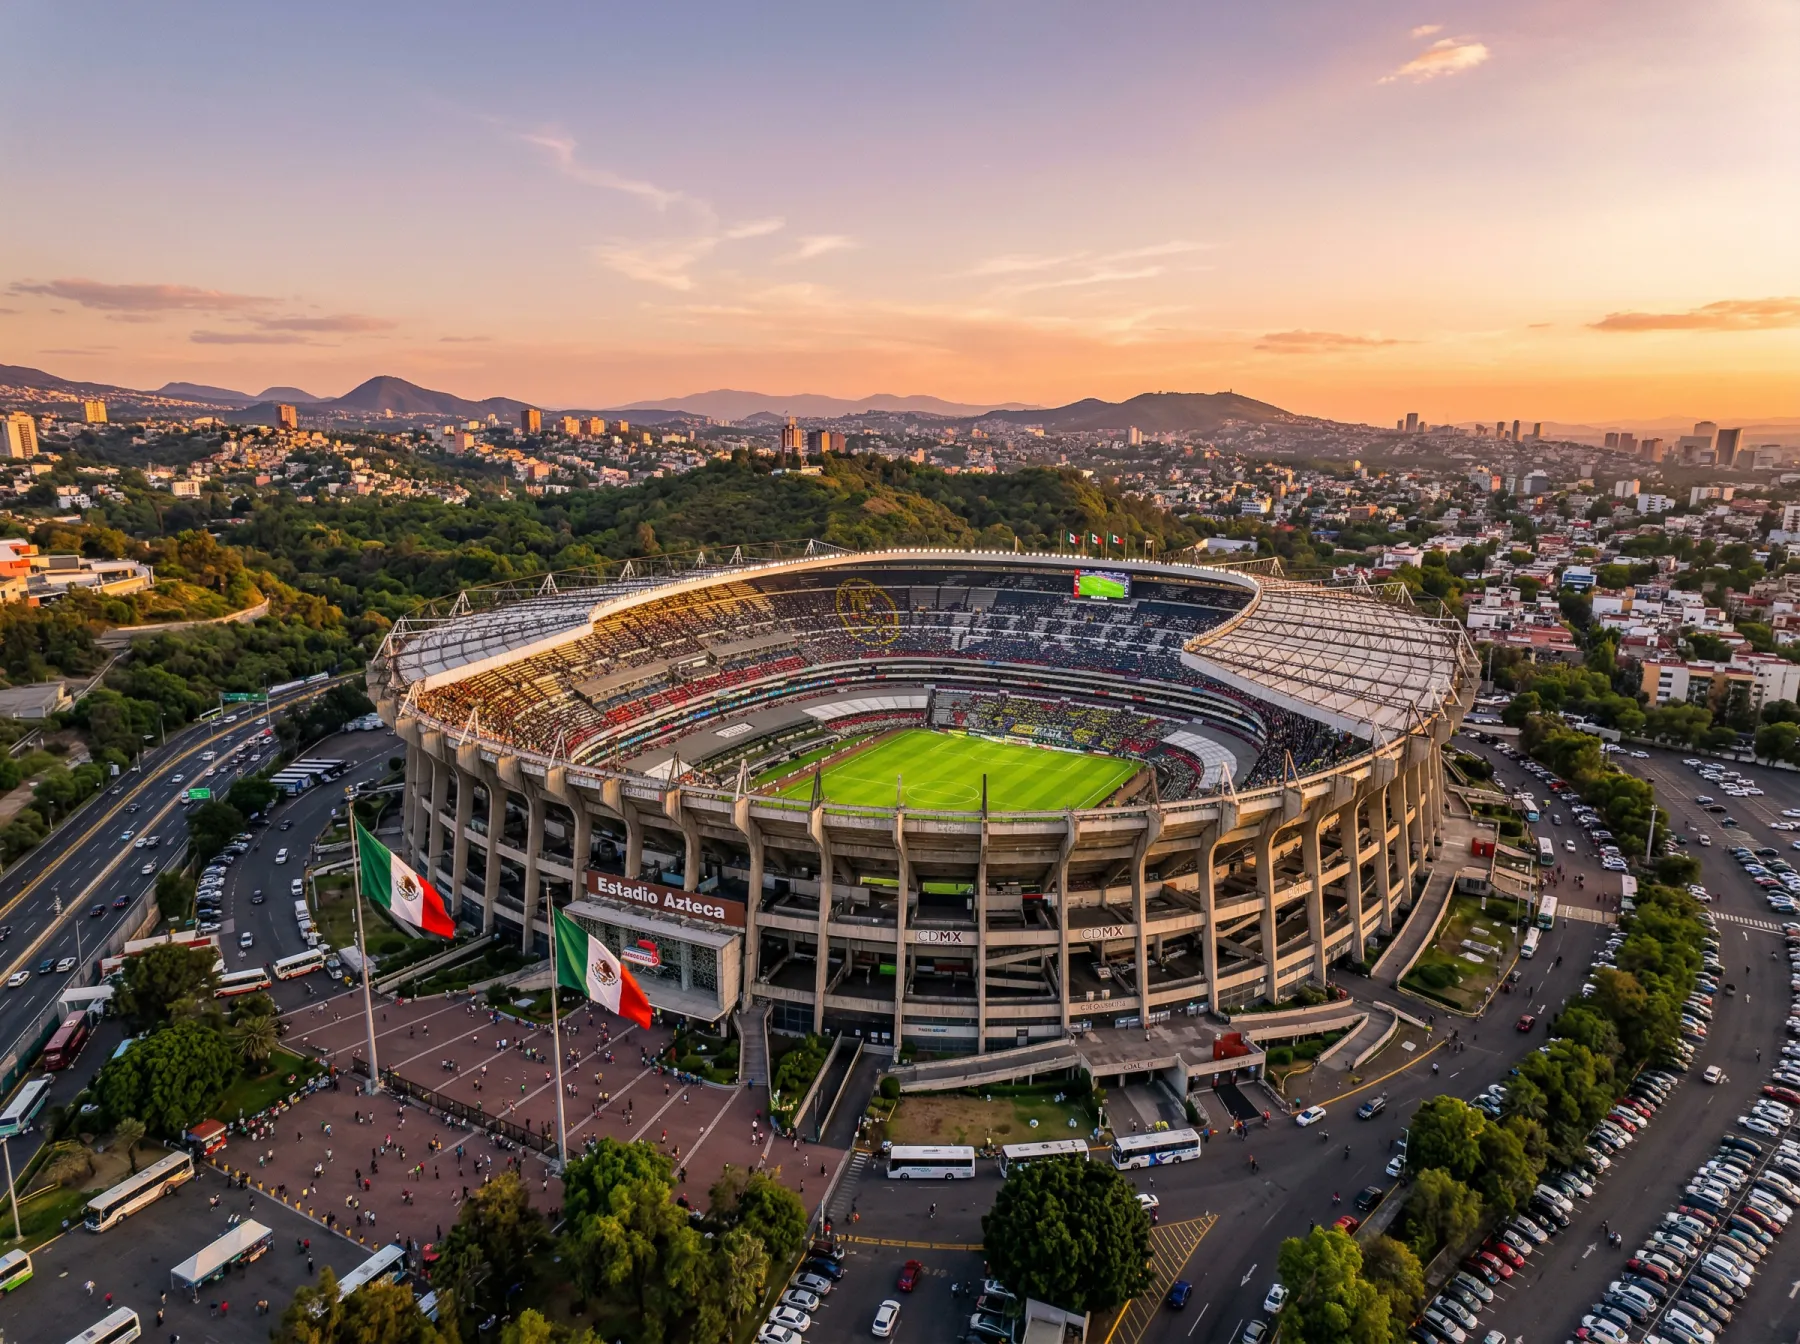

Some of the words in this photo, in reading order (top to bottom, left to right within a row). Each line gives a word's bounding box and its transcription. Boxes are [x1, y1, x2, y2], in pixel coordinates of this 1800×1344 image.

[597, 876, 658, 904] Estadio
[663, 892, 725, 920] Azteca
[918, 930, 962, 942] CDMX
[1082, 925, 1123, 940] CDMX
